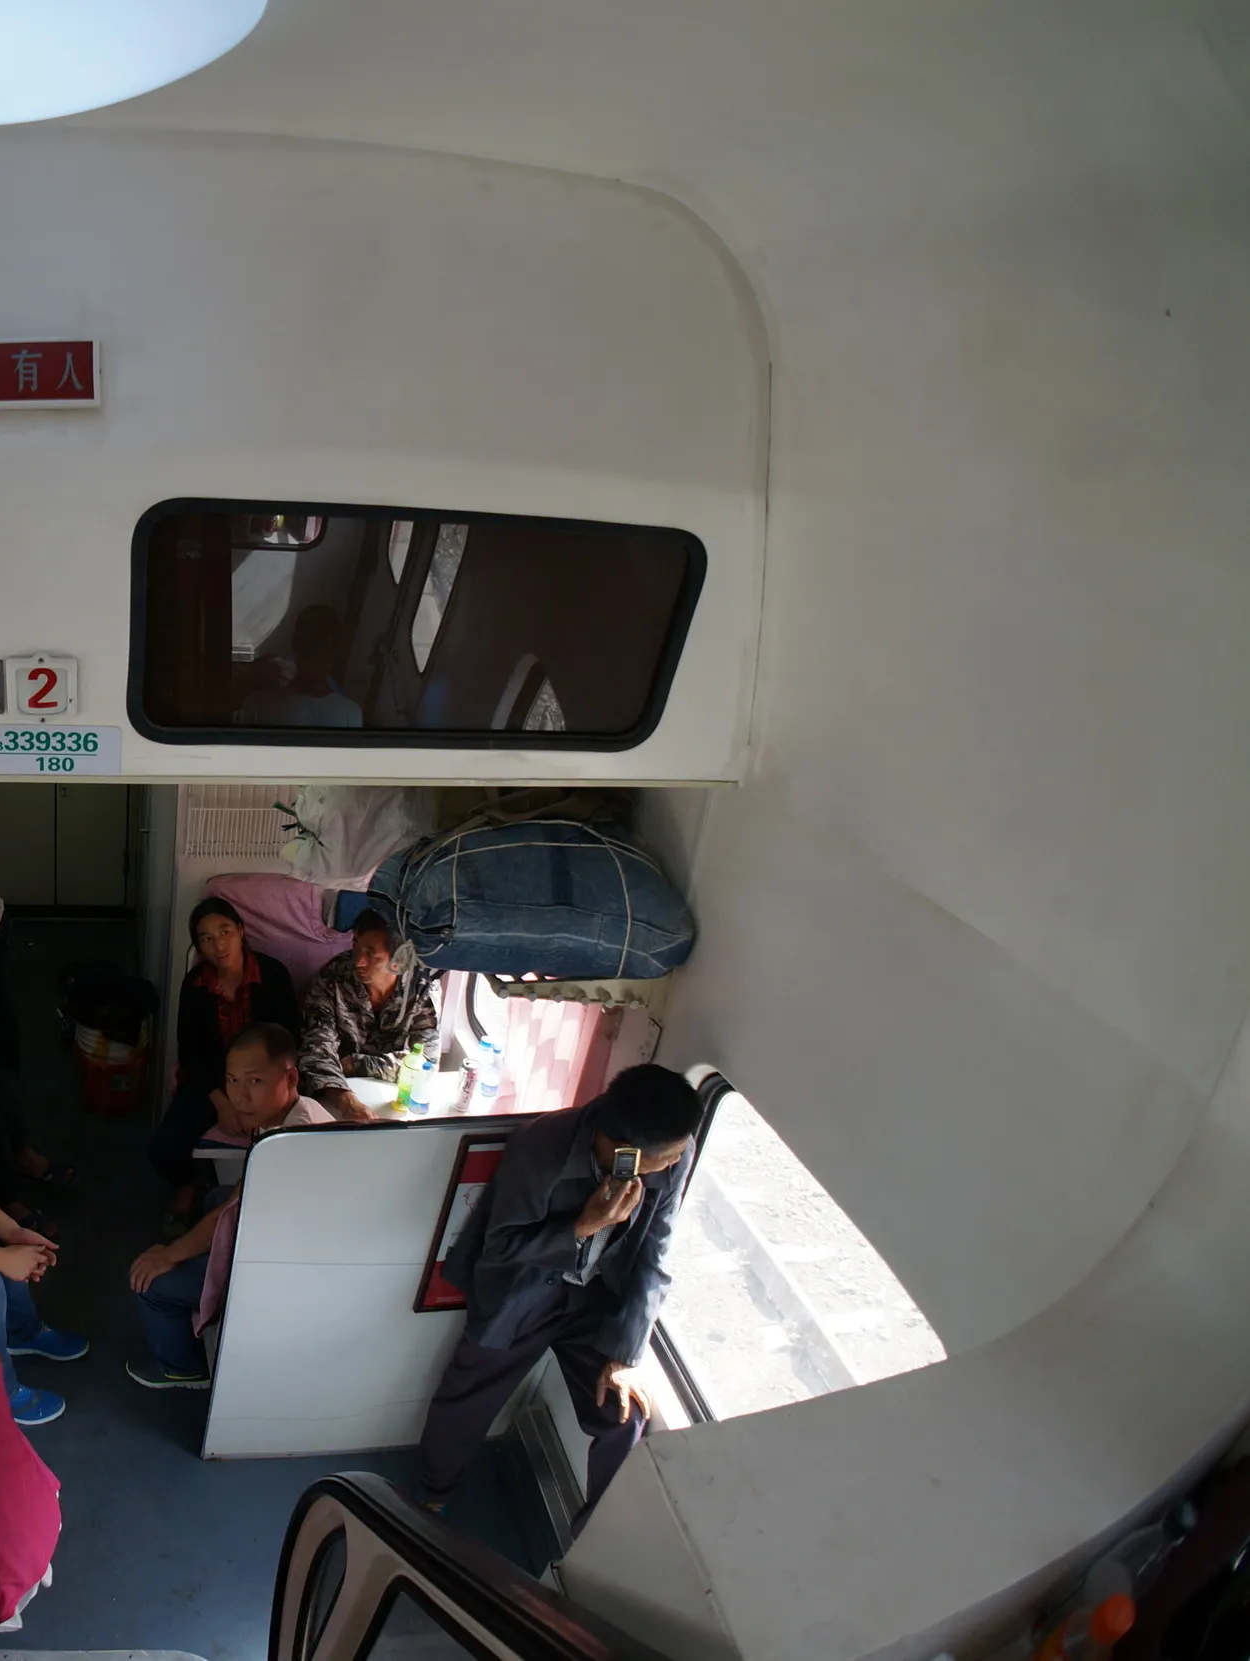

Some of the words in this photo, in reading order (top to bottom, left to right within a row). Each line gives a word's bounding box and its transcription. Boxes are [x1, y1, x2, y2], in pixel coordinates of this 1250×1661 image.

[11, 349, 84, 393] 有人
[27, 667, 59, 709] 2
[35, 757, 75, 772] 180
